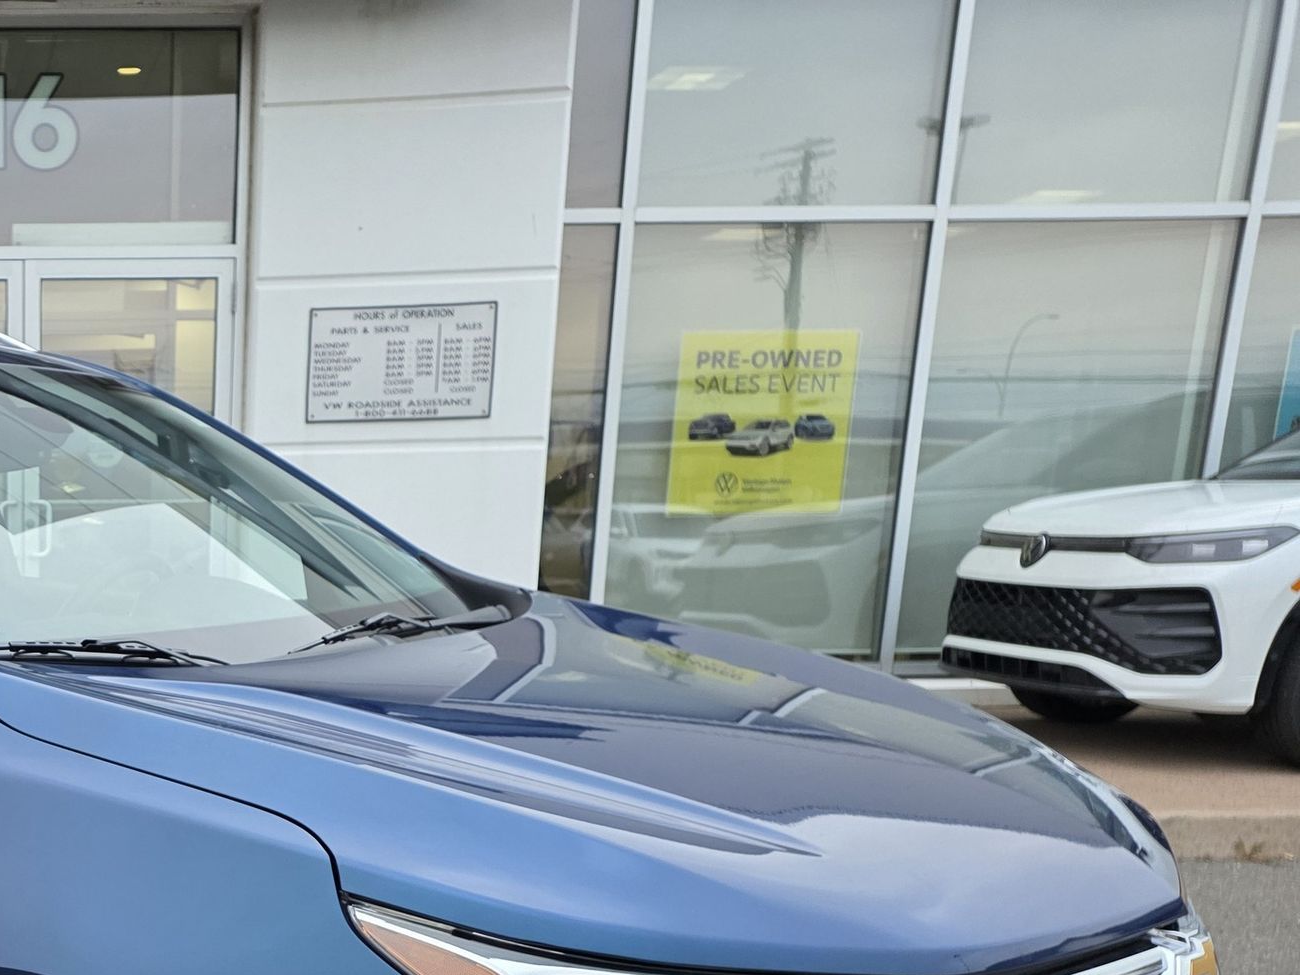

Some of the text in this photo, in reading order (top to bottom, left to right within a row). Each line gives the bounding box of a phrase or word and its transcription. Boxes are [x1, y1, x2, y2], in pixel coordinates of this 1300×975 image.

[353, 311, 386, 321] HOURS
[402, 307, 457, 319] OPERATION
[330, 326, 358, 335] PARTS
[373, 324, 410, 334] SERVICE
[455, 319, 483, 331] SALES
[313, 341, 350, 350] MONDAY
[313, 350, 347, 358] TUESDAY
[695, 349, 843, 370] PRE-OWNED
[313, 365, 353, 373] THURSDAY
[312, 380, 352, 388] SATURDAY
[694, 373, 841, 395] SALES EVENT
[312, 390, 339, 398] SUNDAY
[323, 398, 471, 410] VW ROADSIDE ASSISTANCE
